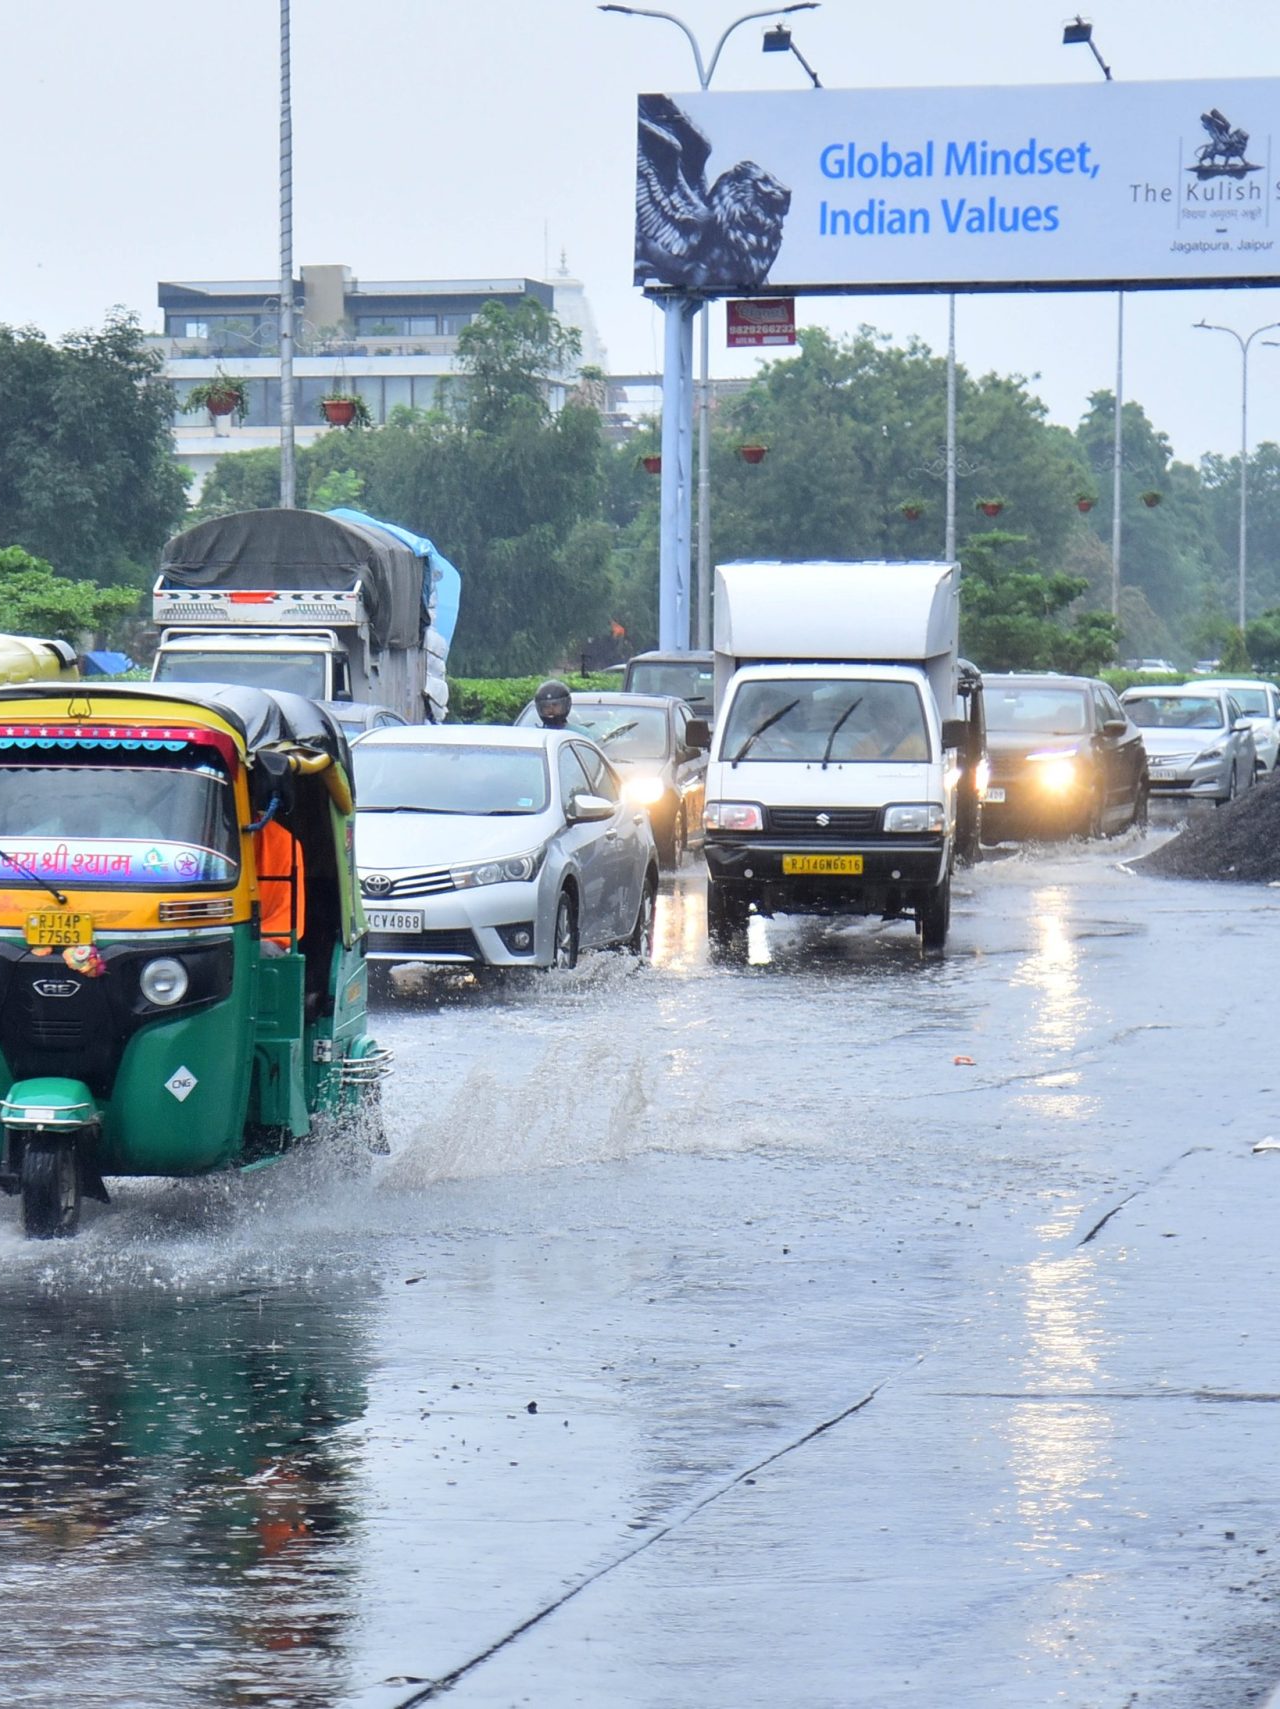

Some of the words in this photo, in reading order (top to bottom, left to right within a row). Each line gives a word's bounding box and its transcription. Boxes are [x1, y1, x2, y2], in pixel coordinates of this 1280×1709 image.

[820, 140, 934, 179] Global
[944, 137, 1100, 179] Mindset,
[1129, 182, 1173, 203] The
[1186, 181, 1262, 201] Kulish
[819, 199, 931, 235] Indian
[940, 196, 1060, 233] Values
[1169, 240, 1233, 254] Jagatpura,
[1237, 239, 1274, 252] Jaipur
[41, 843, 70, 872] श्री
[72, 853, 132, 876] श्याम
[39, 914, 81, 929] RJ14P
[39, 929, 81, 944] F7563
[172, 1078, 192, 1089] CNG
